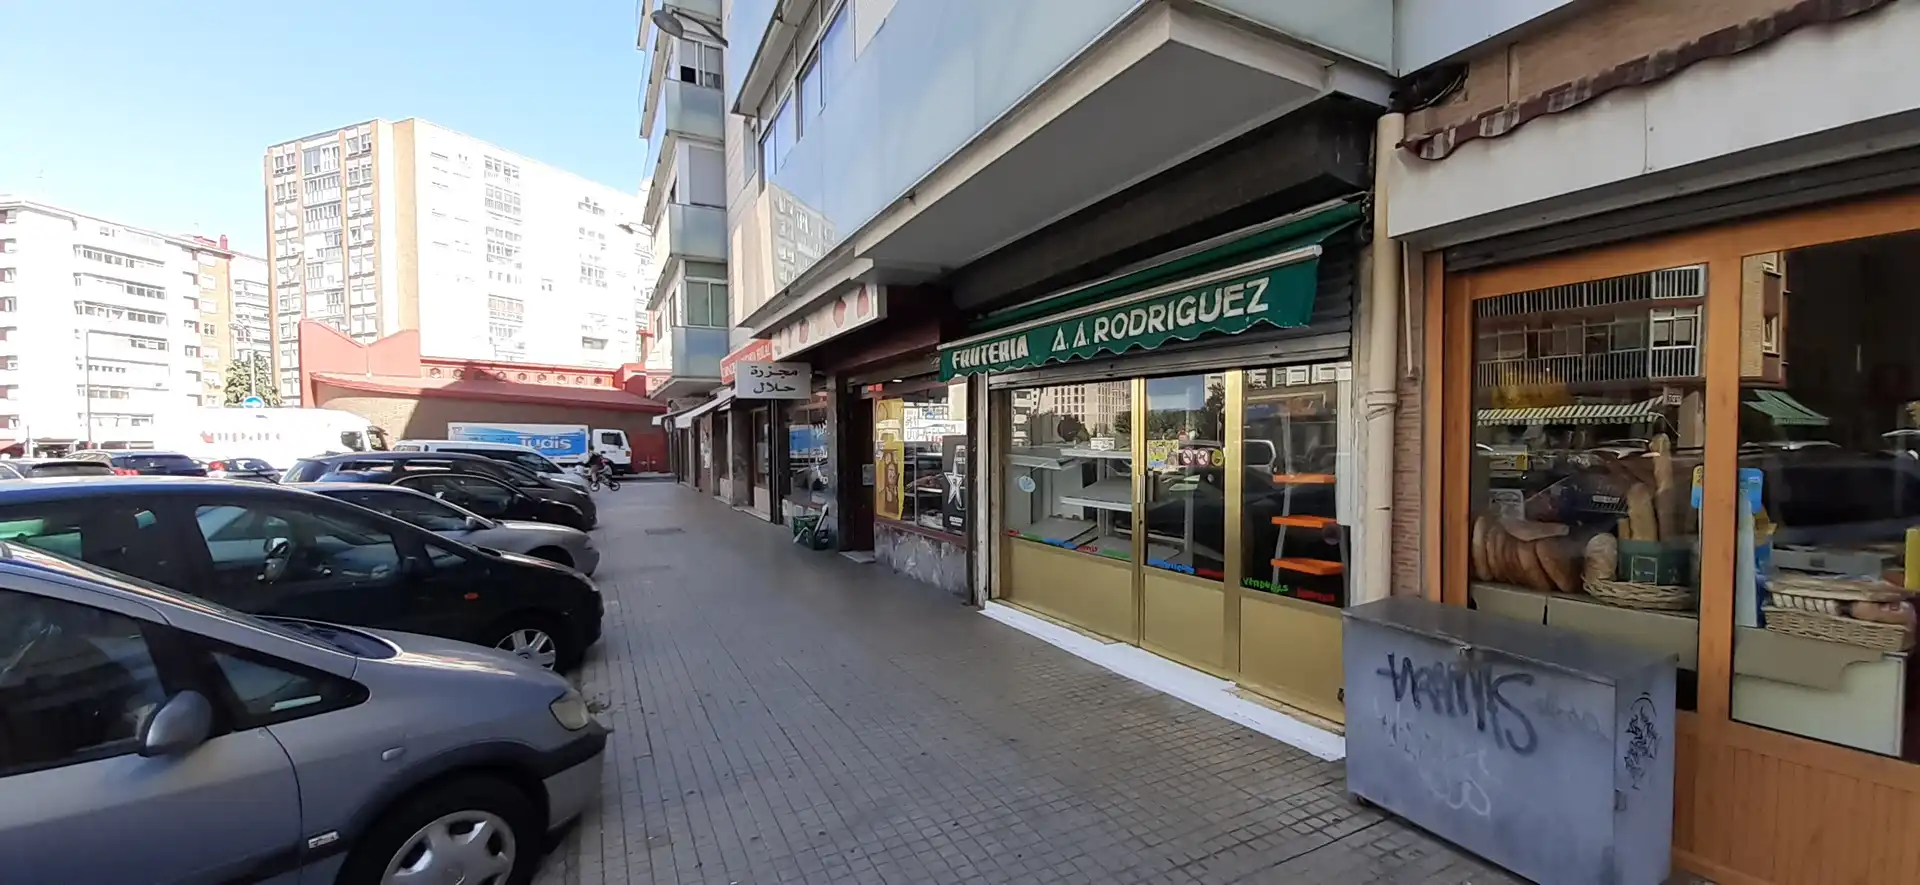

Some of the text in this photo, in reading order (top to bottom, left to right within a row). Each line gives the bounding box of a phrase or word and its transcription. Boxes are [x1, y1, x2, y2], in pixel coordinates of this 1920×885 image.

[952, 335, 1029, 369] FRUTERIA
[1094, 277, 1270, 343] RODRIGUEZ
[750, 365, 798, 379] مجزرة
[753, 381, 796, 394] حلال
